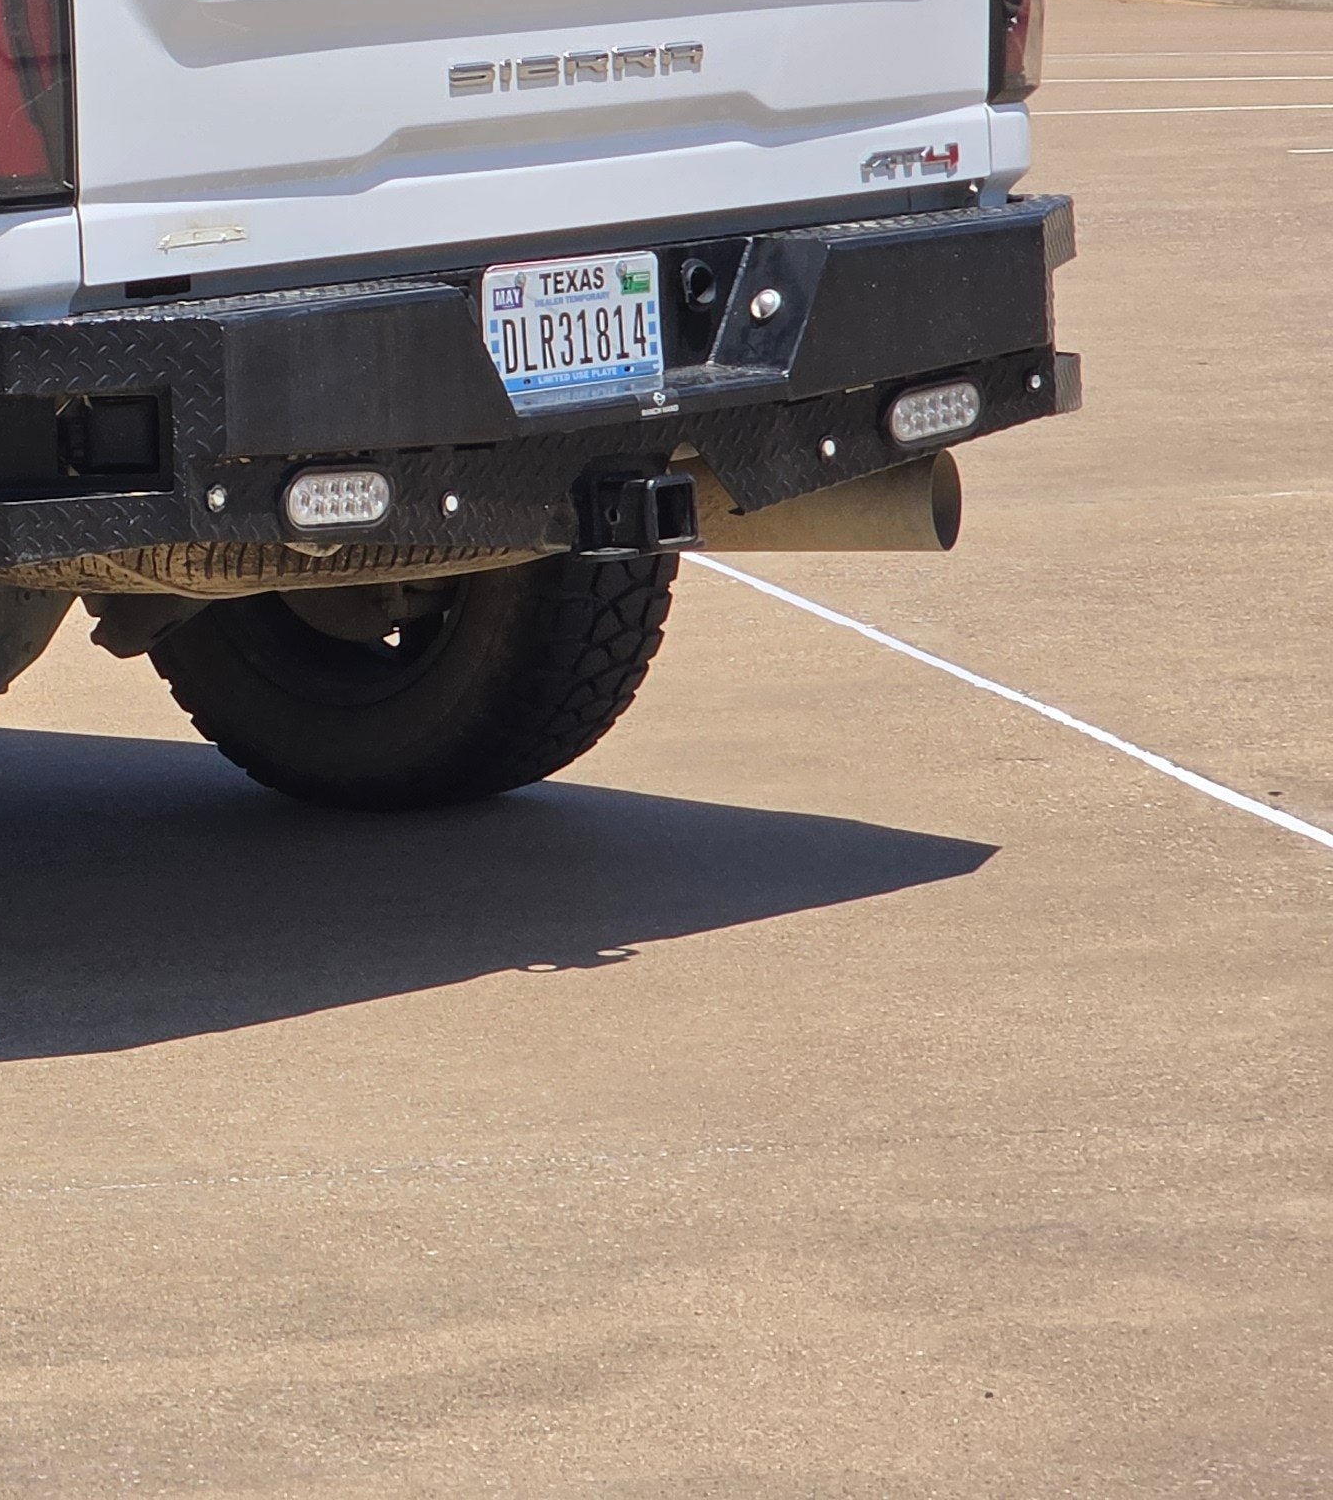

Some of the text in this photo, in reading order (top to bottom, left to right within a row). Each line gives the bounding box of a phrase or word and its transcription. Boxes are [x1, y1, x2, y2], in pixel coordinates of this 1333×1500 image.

[448, 39, 704, 89] SIERRA
[859, 142, 959, 174] AT4
[495, 288, 521, 306] MAY
[538, 266, 606, 297] TEXAS
[501, 301, 648, 375] DLR31814
[591, 366, 618, 379] PLATE
